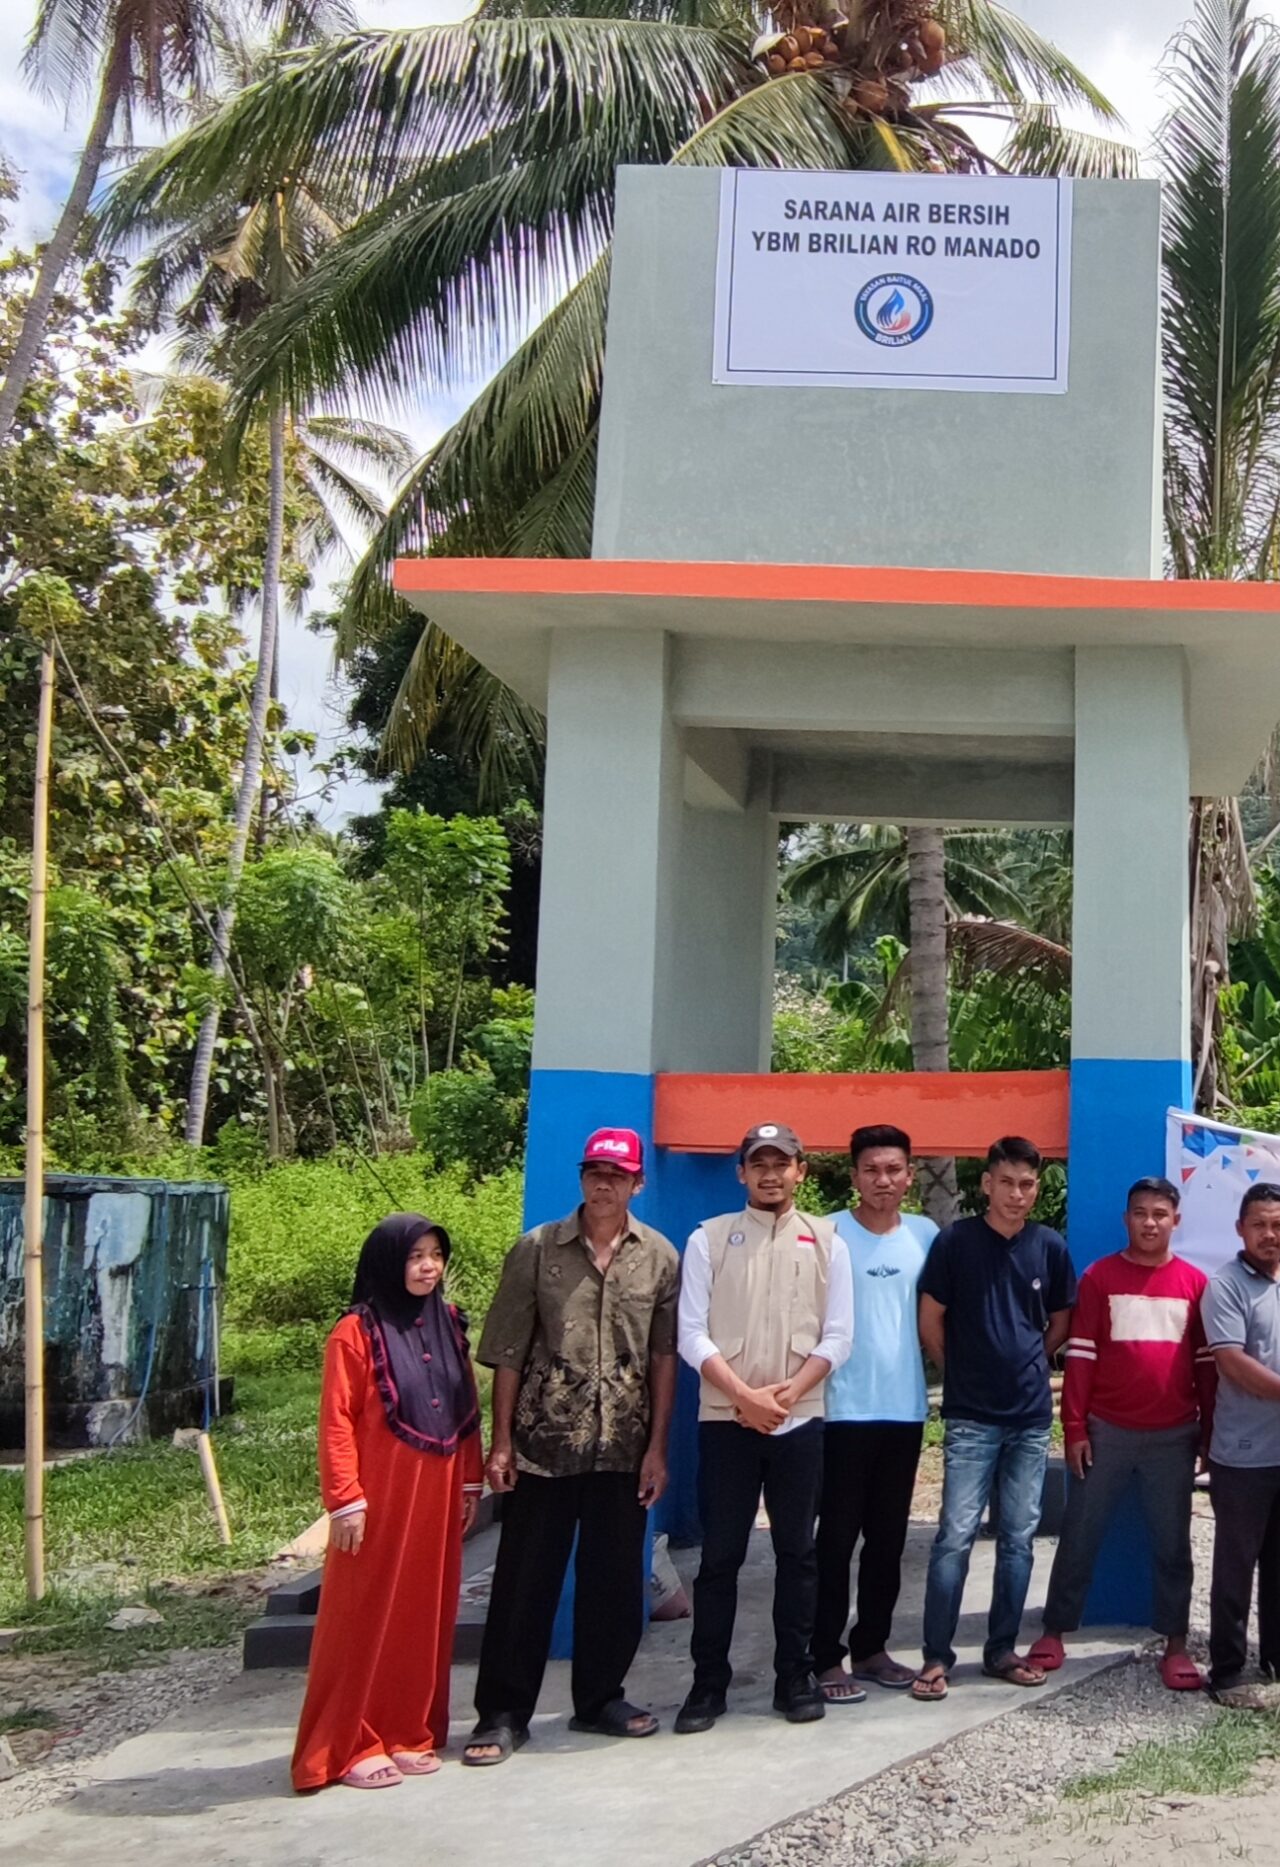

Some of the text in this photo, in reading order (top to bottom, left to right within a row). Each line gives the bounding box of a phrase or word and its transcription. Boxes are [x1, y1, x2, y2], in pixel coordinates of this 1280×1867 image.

[784, 199, 1011, 226] SARANA AIR BERSIH
[752, 231, 1041, 260] YBM BRILIAN RO MANADO
[593, 1139, 630, 1153] FILA
